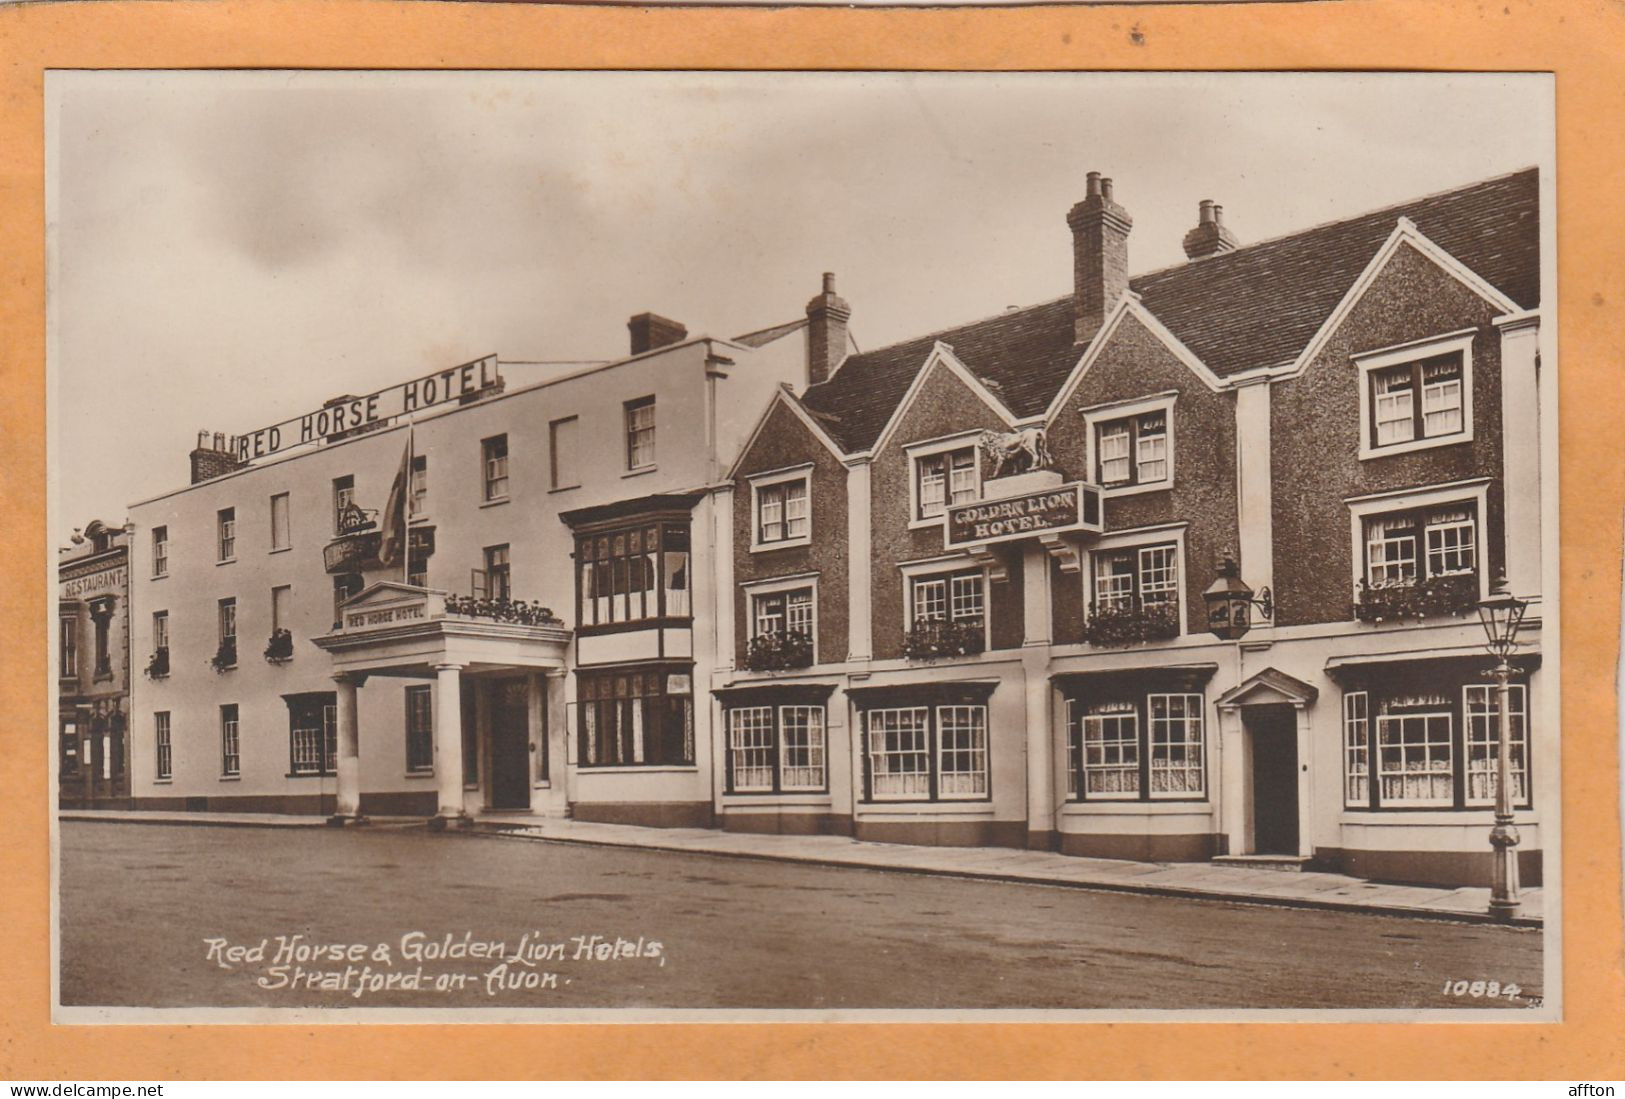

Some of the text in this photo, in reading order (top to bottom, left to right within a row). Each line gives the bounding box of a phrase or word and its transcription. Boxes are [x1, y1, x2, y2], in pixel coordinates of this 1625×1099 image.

[238, 361, 495, 461] RED HORSE HOTEL
[955, 491, 1076, 525] GOLDEN LION
[65, 569, 123, 597] RESTAURANT
[349, 607, 424, 627] RED HORSE HOTEL
